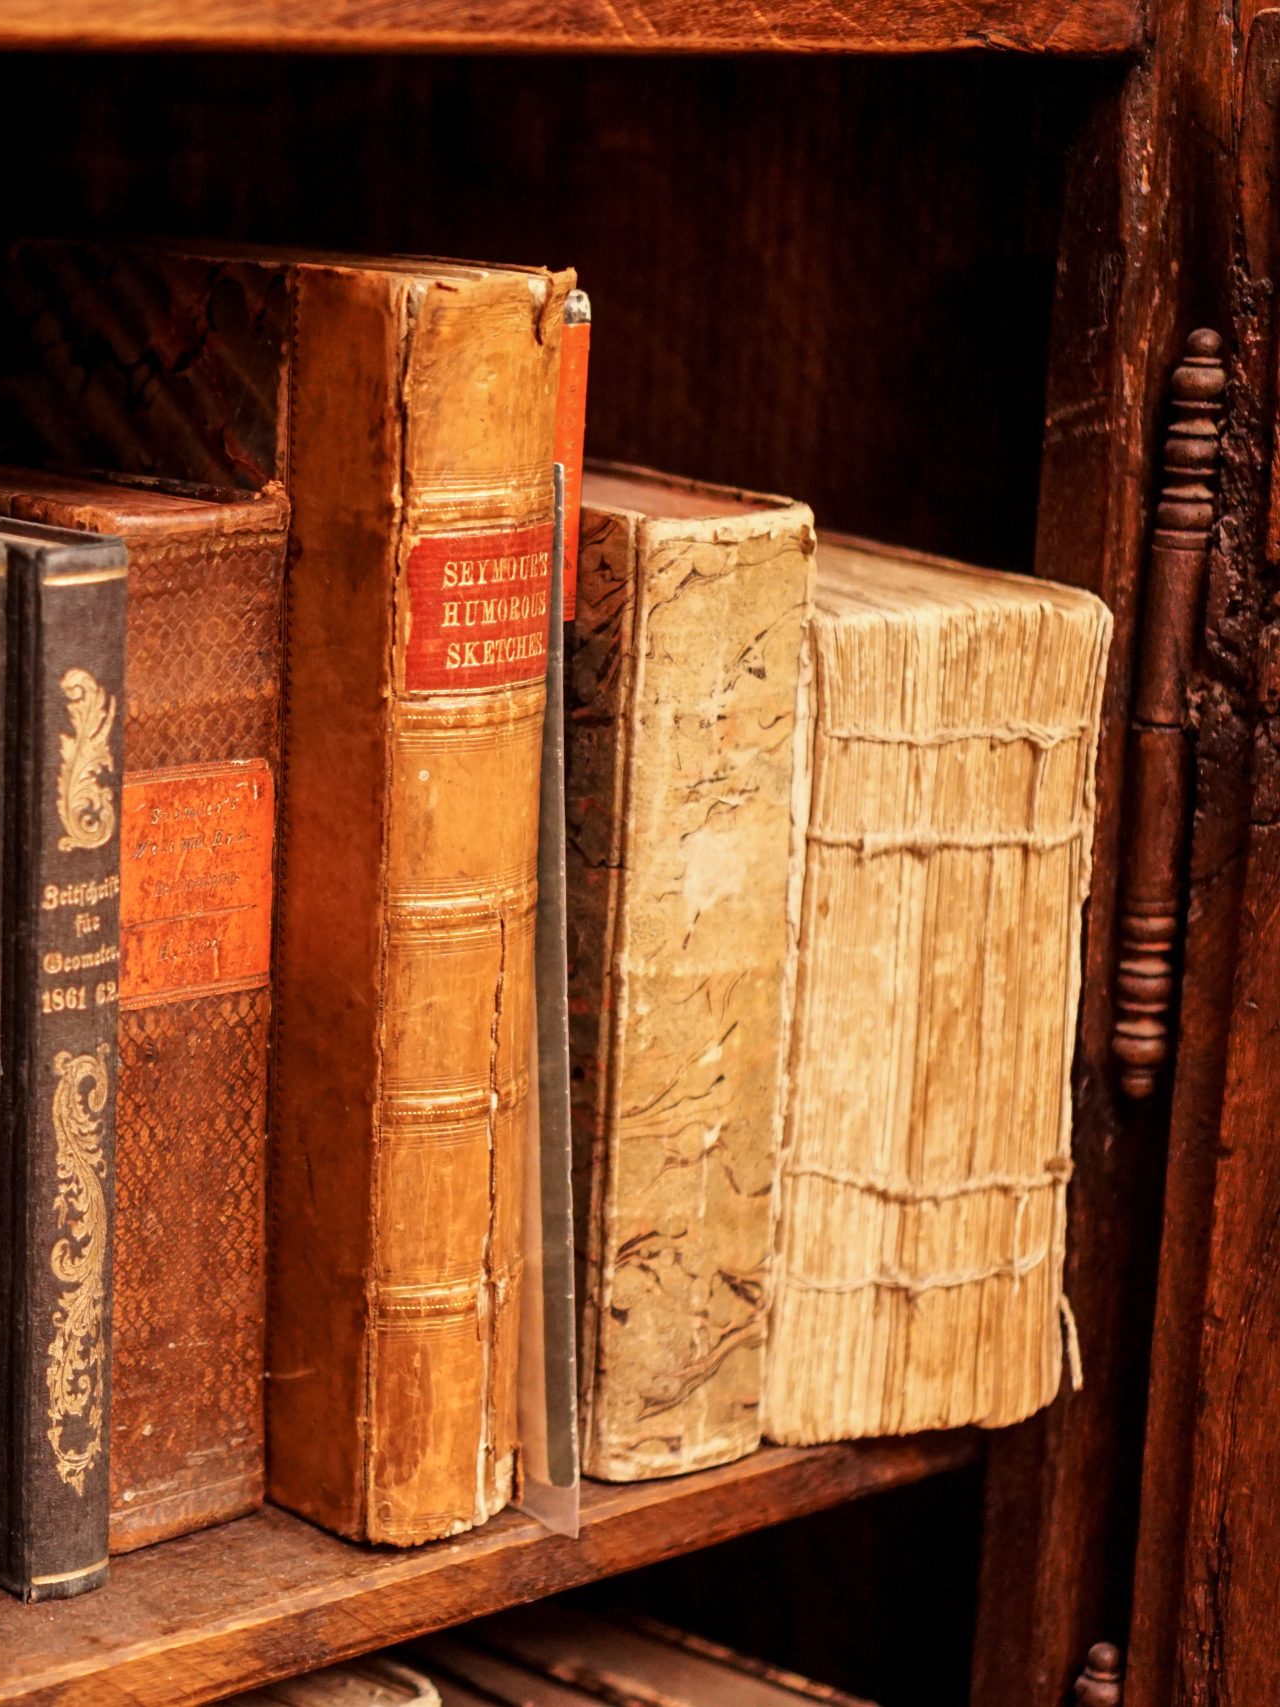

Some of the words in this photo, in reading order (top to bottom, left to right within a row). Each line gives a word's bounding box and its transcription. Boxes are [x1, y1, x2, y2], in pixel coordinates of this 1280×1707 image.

[441, 552, 548, 590] SEYMOUR'S
[441, 590, 547, 627] HUMOROUS
[446, 632, 546, 669] SKETCHES.
[42, 986, 87, 1013] 1861
